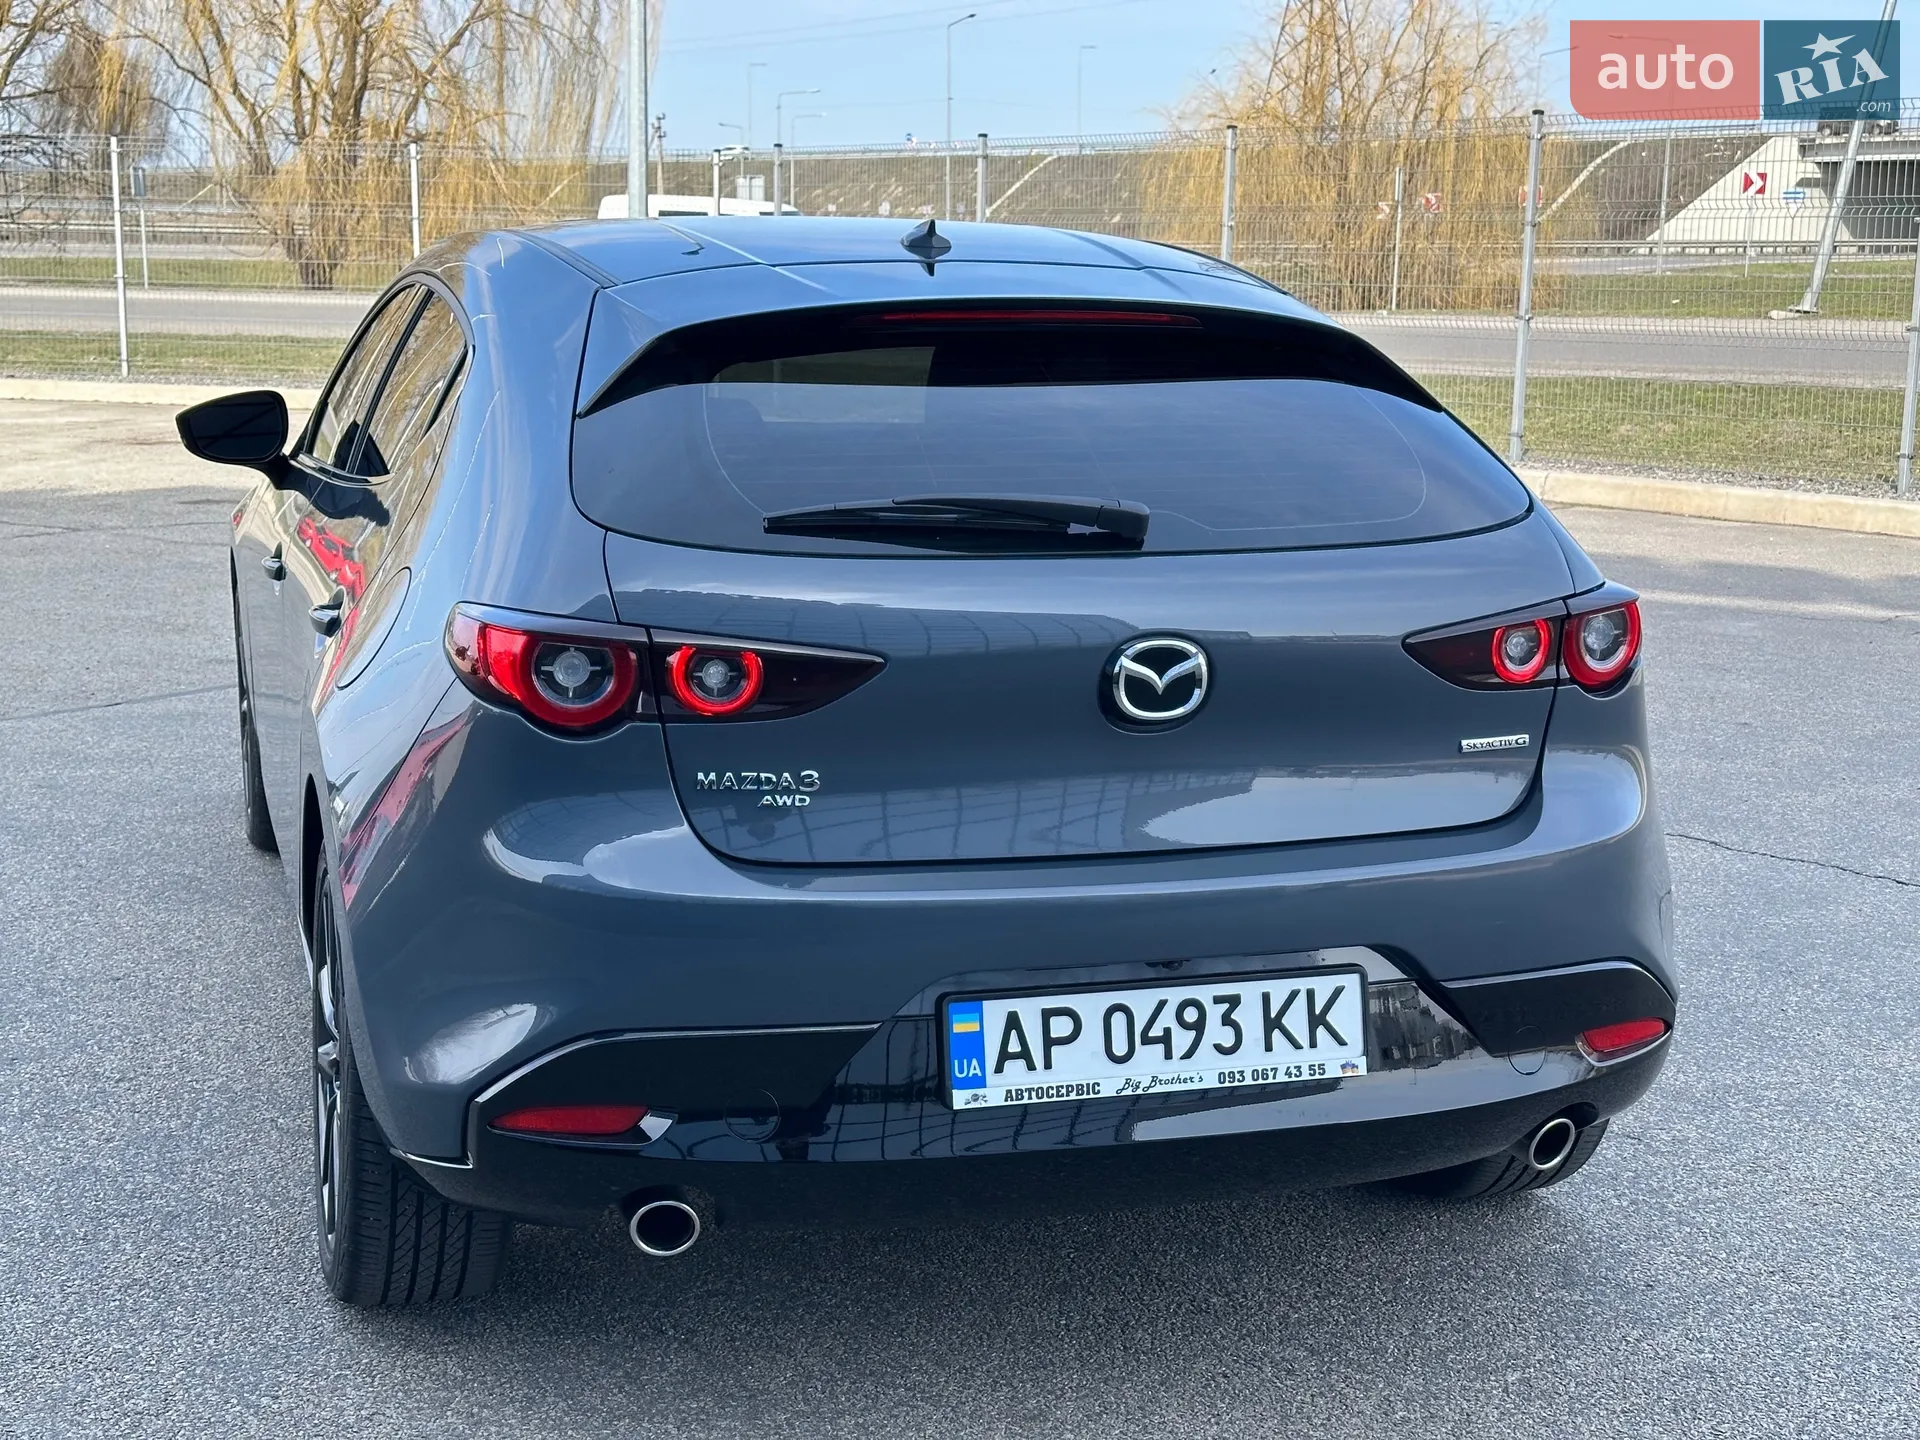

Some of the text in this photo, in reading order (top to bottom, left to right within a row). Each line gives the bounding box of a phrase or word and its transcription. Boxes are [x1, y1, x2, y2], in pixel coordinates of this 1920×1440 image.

[757, 795, 811, 807] AWD
[993, 985, 1348, 1074] AP 0493 KK
[954, 1059, 982, 1078] UA
[1218, 1063, 1326, 1084] 093 067 43 55
[1004, 1082, 1101, 1102] АВТОСЕРВІС
[1116, 1072, 1204, 1095] Big Brother's
